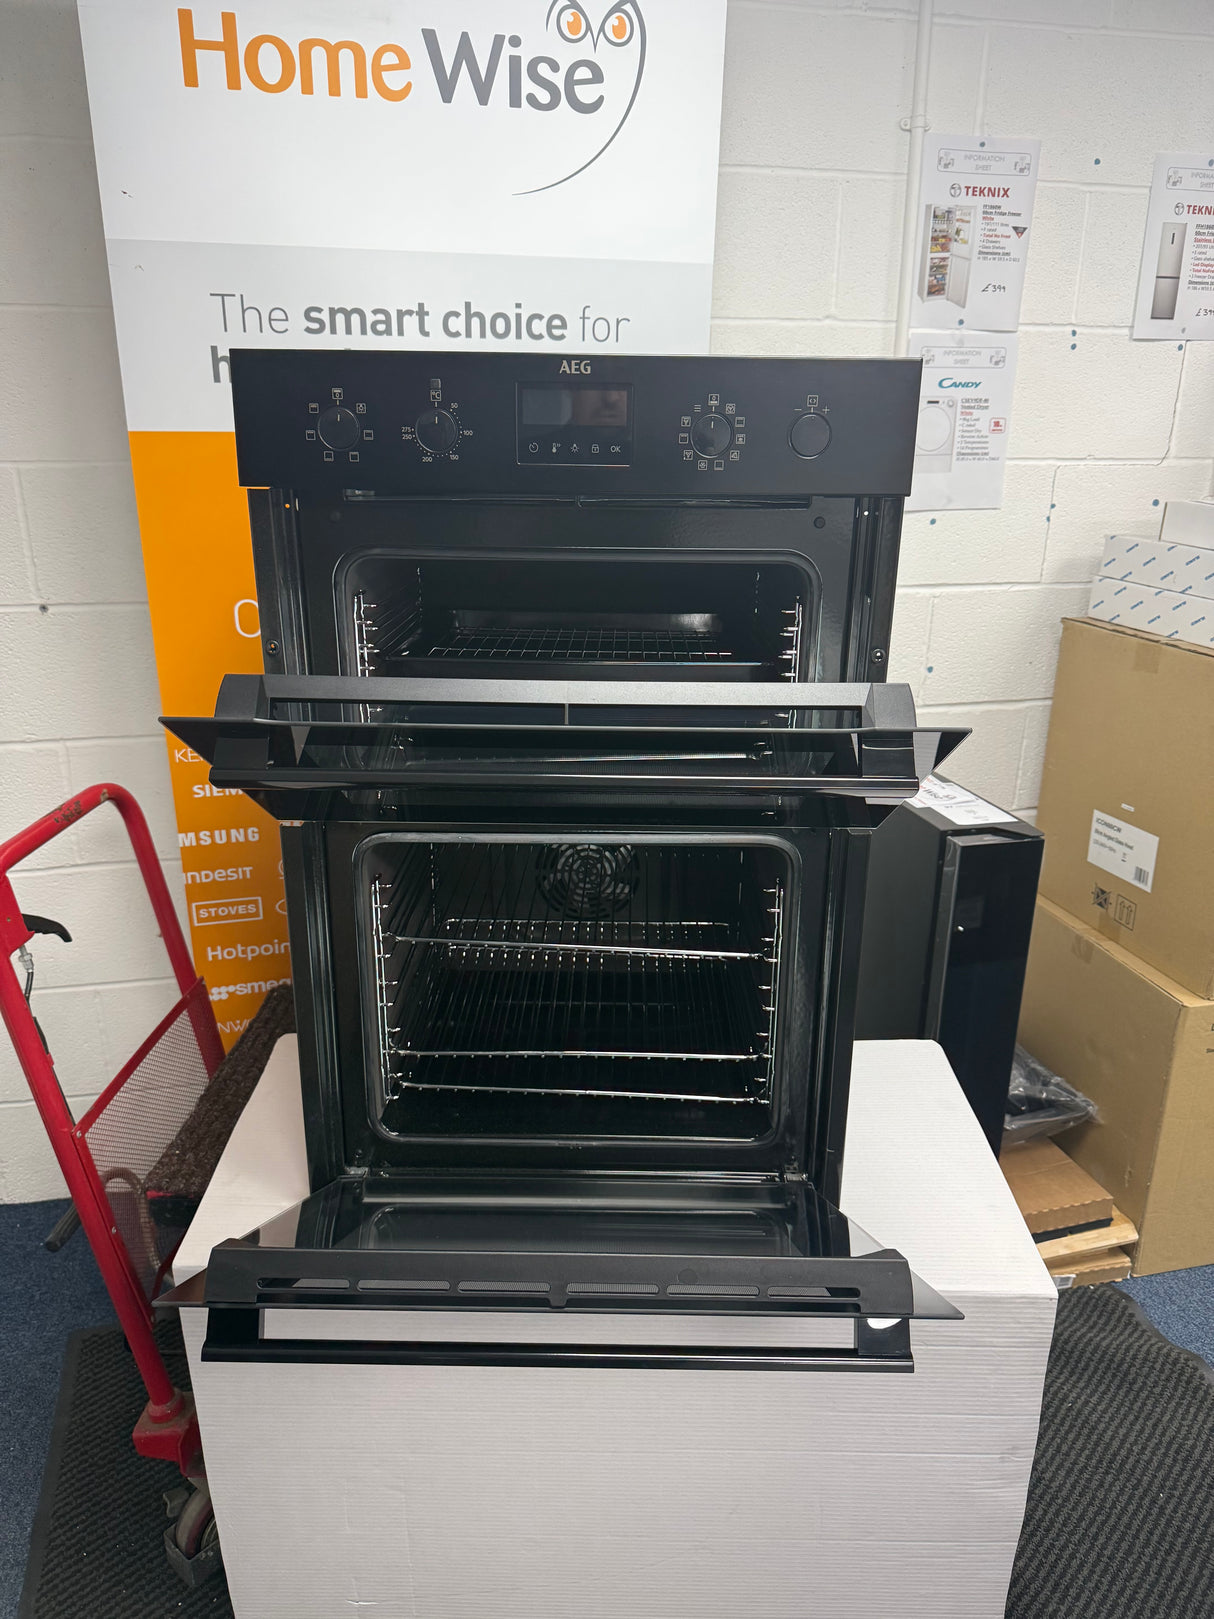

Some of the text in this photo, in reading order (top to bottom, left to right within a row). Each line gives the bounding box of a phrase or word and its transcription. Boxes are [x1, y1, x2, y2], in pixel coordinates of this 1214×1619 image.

[177, 7, 605, 114] Home Wise
[963, 154, 1005, 163] INFORMATION
[964, 185, 1010, 198] TEKNIX
[209, 292, 631, 343] The smart choice for
[559, 360, 591, 374] AEG
[610, 445, 621, 453] OK
[178, 827, 259, 847] MSUNG
[199, 904, 257, 918] STOVES
[207, 939, 290, 961] Hotpoin
